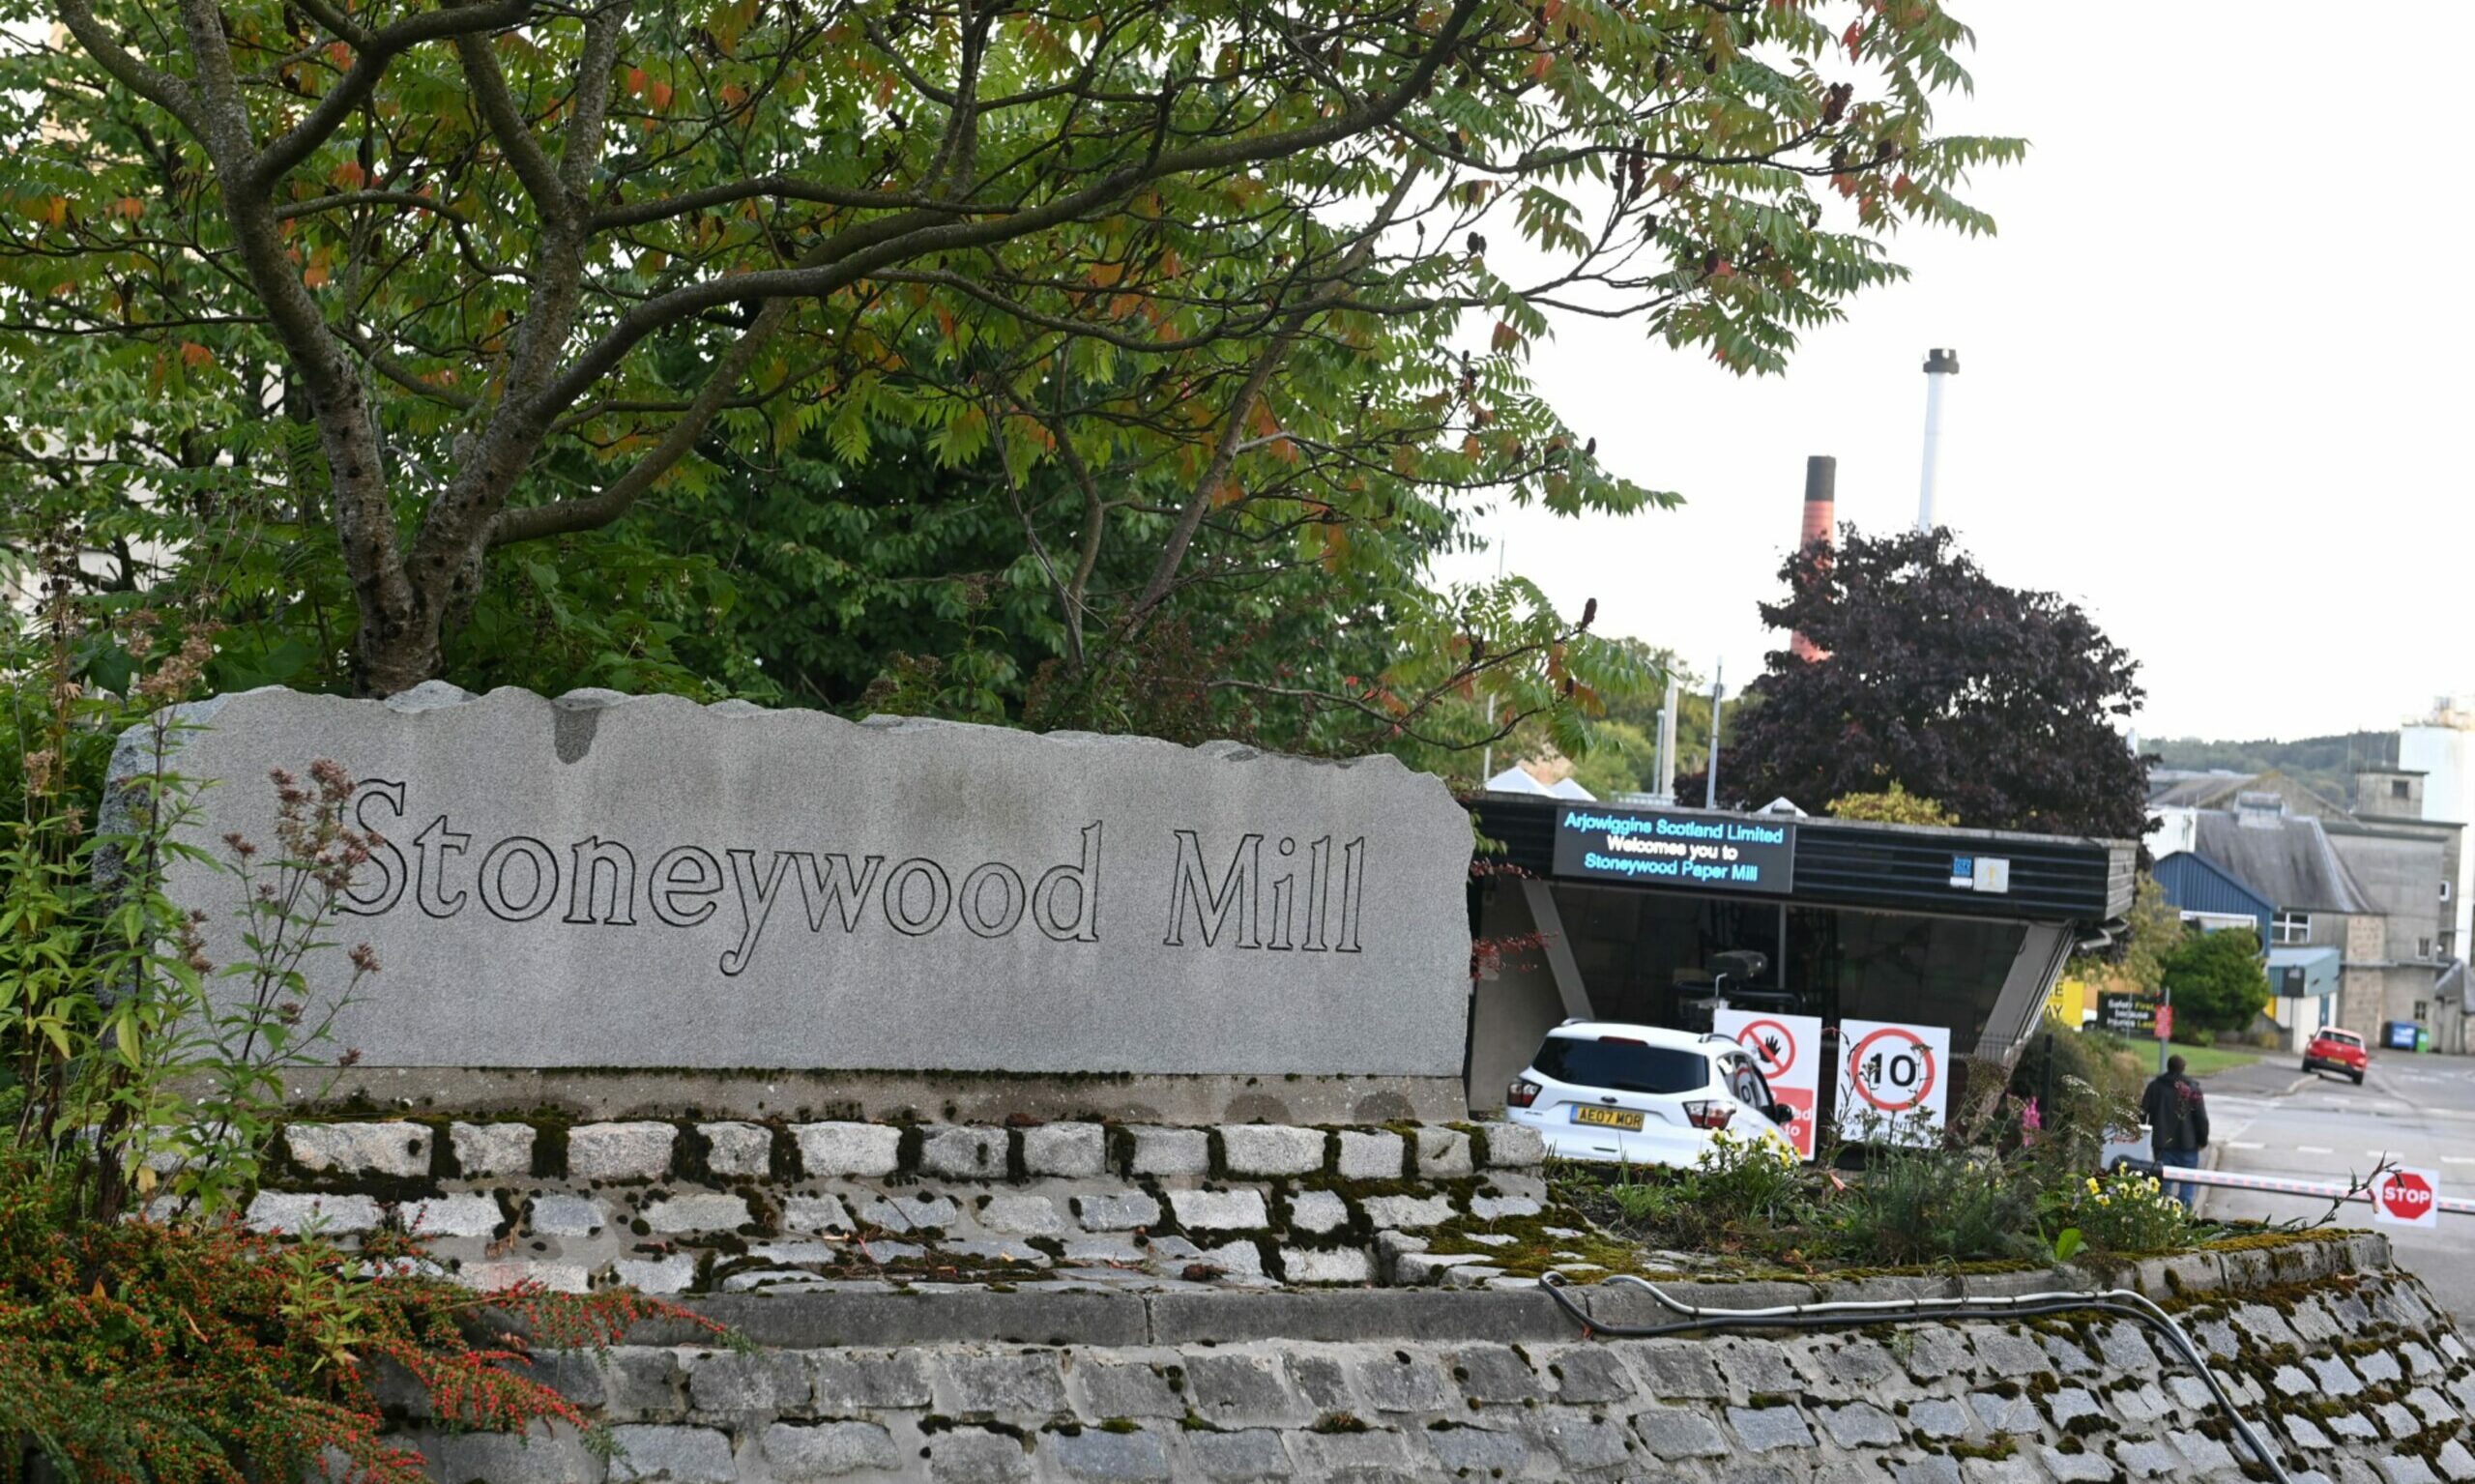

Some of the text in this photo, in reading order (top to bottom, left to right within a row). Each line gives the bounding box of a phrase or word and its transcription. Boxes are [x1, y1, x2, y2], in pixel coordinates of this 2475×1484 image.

[1563, 811, 1784, 844] Arjowiggins Scotland Limited
[1606, 834, 1739, 861] Welcomes you to
[330, 778, 1365, 976] Stoneywood Mill
[1584, 852, 1759, 882] Stoneywood Paper Mill
[1870, 1052, 1917, 1088] 10
[1578, 1106, 1613, 1123] AE07
[2384, 1186, 2431, 1205] STOP
